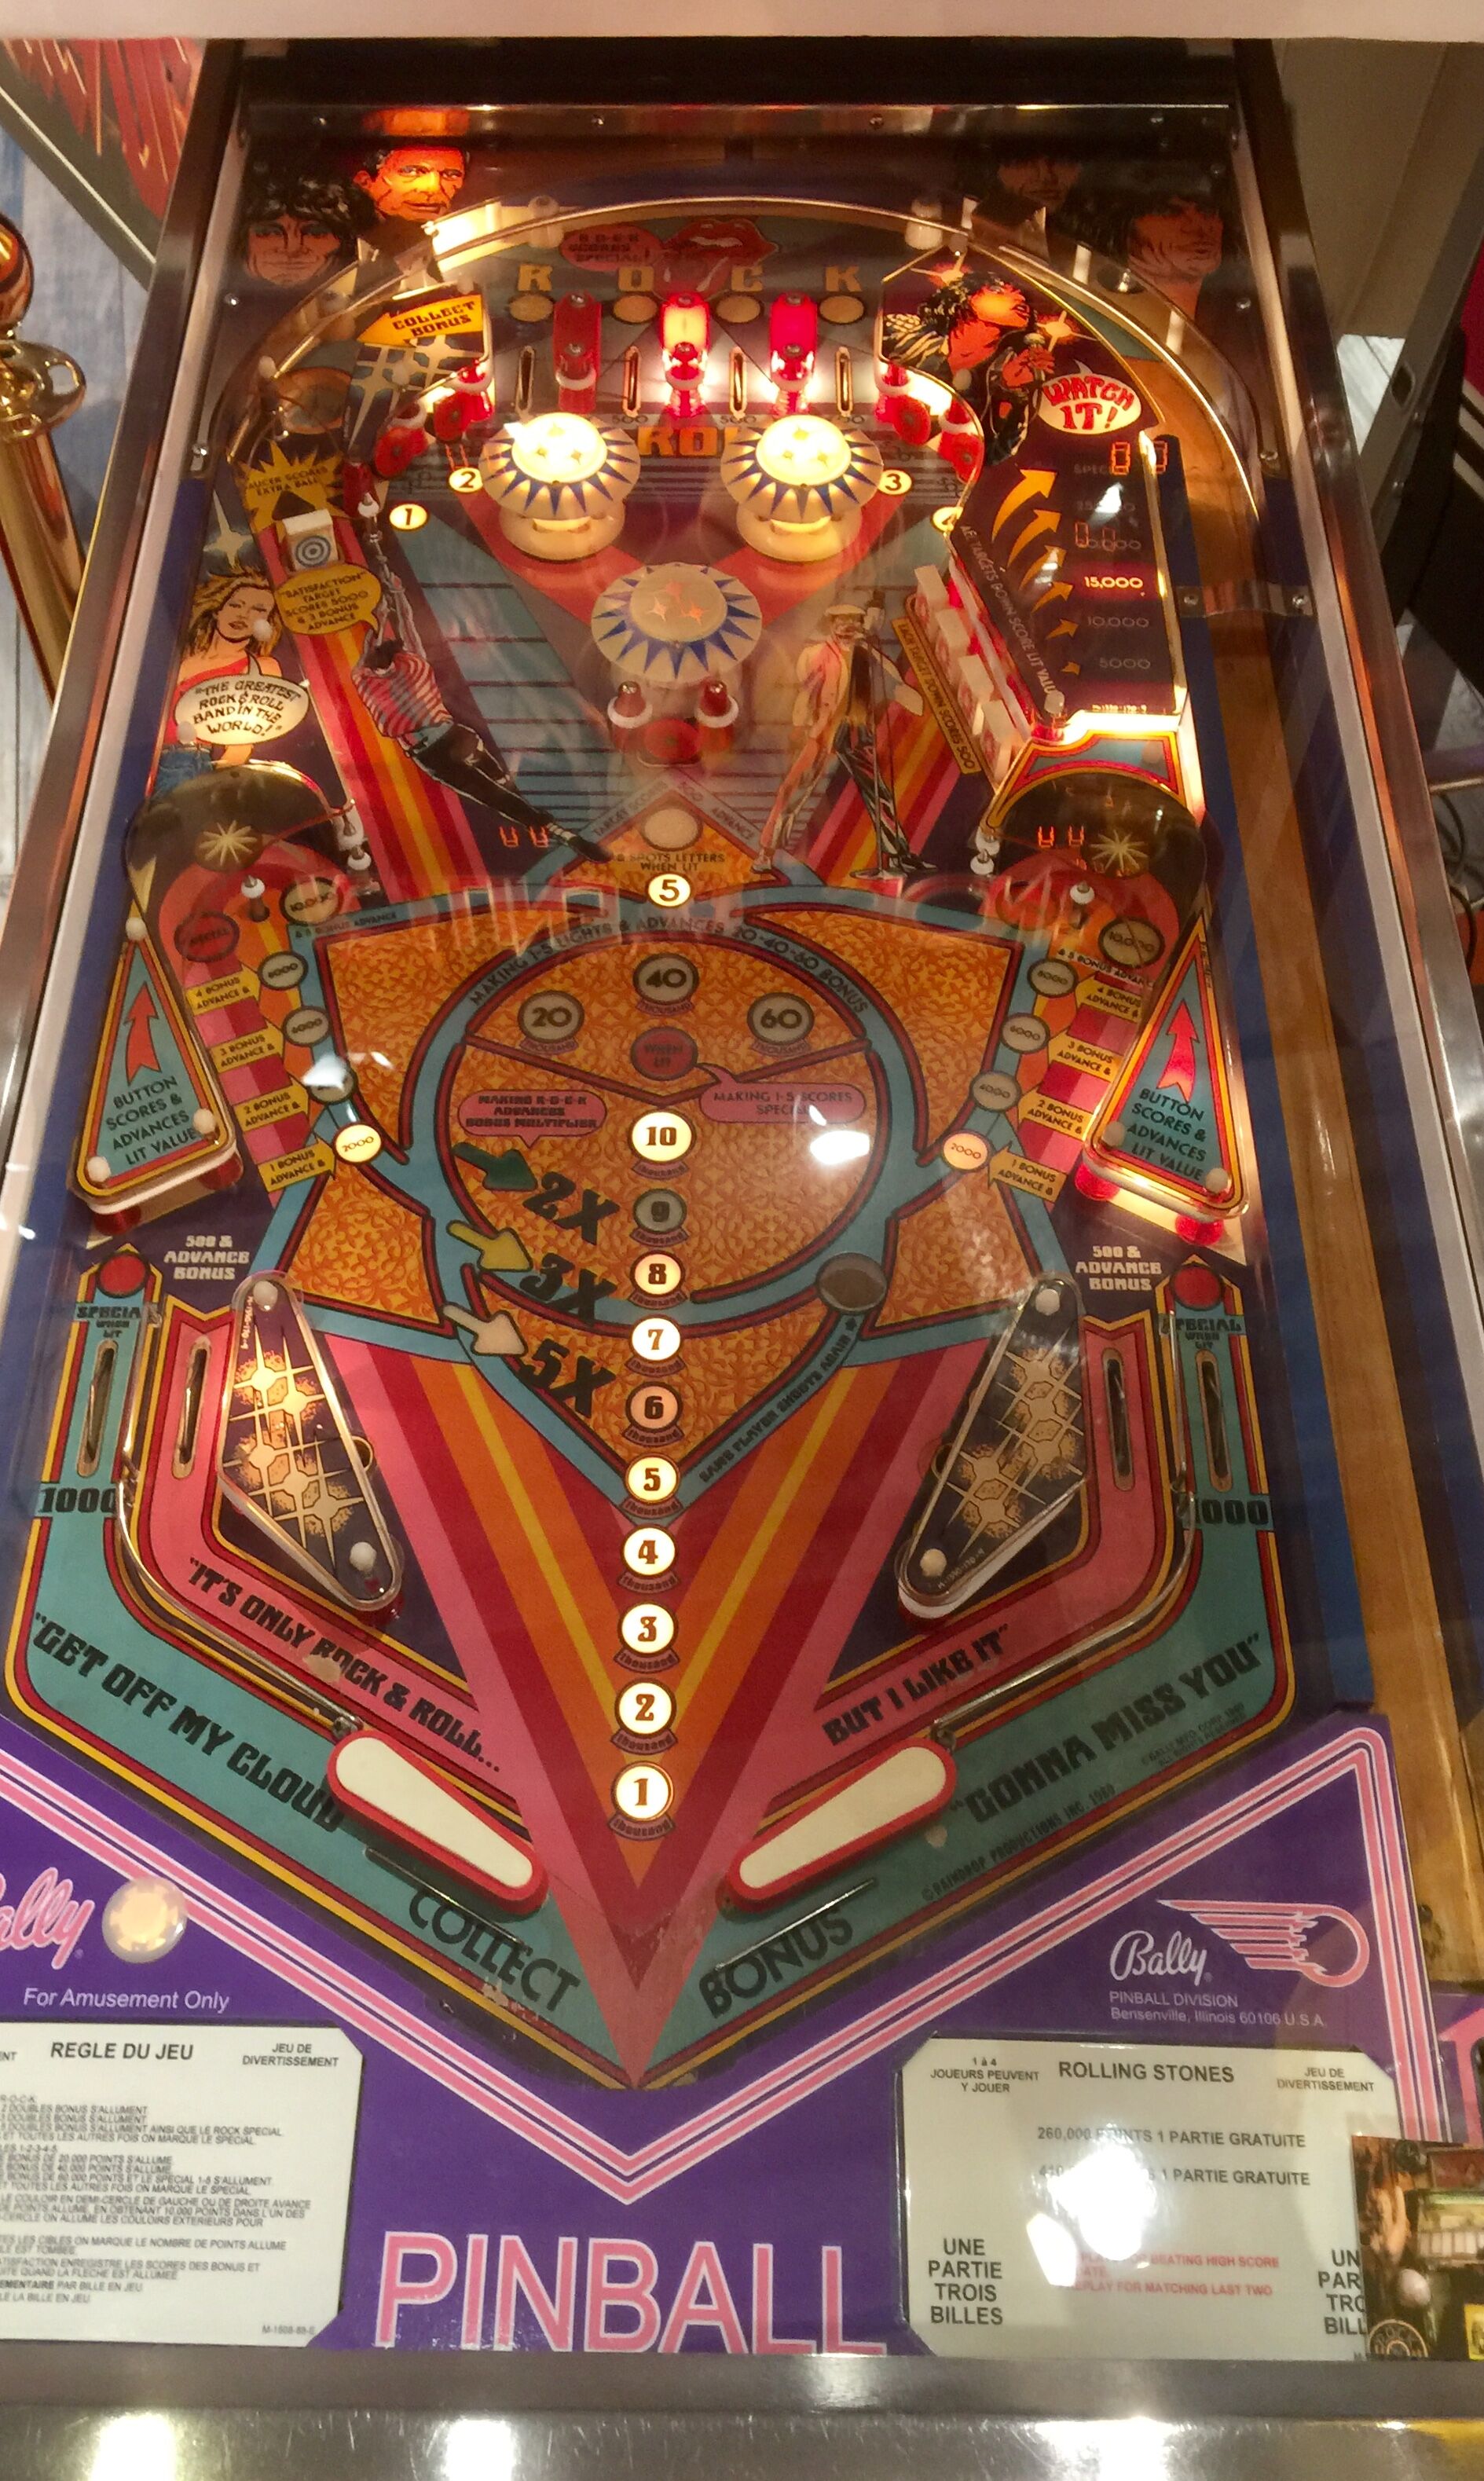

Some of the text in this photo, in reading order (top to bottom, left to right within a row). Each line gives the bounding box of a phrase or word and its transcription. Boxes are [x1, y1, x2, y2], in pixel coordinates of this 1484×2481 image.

[517, 264, 863, 292] R O C K
[392, 301, 476, 332] COLLECT
[411, 313, 471, 338] BONUS
[1041, 376, 1133, 411] WATCH
[1062, 401, 1117, 431] IT!
[459, 471, 476, 489] 2
[883, 474, 903, 492] 3
[404, 508, 413, 526] 1
[1083, 575, 1144, 589] 15,000
[285, 599, 328, 617] SCORES
[318, 603, 360, 618] BONUS
[307, 614, 357, 630] ADVANCE
[1008, 617, 1036, 651] SCORE
[199, 691, 284, 712] ROCK & ROLL
[235, 680, 302, 702] GREATEST
[193, 705, 282, 724] BAND IN THE
[640, 863, 698, 872] WHEN LIT
[676, 853, 726, 863] LETTERS
[658, 878, 680, 902] 5
[469, 957, 530, 1007] MAKING
[556, 921, 612, 951] LIGHTS
[634, 918, 725, 935] ADVANCES
[817, 964, 870, 1014] BONUS
[205, 977, 240, 994] BONUS
[645, 967, 688, 988] 40
[196, 991, 240, 1010] ADVANCE
[529, 1006, 572, 1028] 20
[759, 1008, 804, 1030] 60
[229, 1034, 266, 1053] BONUS
[1076, 1044, 1114, 1064] BONUS
[220, 1049, 264, 1068] ADVANCE
[1057, 1050, 1101, 1072] ADVANCE
[113, 1076, 178, 1109] BUTTON
[254, 1091, 291, 1110] BONUS
[715, 1090, 852, 1103] MAKING SCORES
[105, 1092, 183, 1132] SCORES &
[1047, 1102, 1084, 1123] BONUS
[1138, 1087, 1205, 1122] BUTTON
[245, 1107, 289, 1127] ADVANCE
[1028, 1108, 1072, 1131] ADVANCE
[1131, 1103, 1208, 1142] SCORES &
[112, 1109, 190, 1152] ADVANCES
[644, 1125, 678, 1147] 10
[126, 1127, 197, 1165] LIT VALUE
[342, 1136, 375, 1153] 2000
[951, 1142, 982, 1160] 2000
[1127, 1122, 1207, 1163] ADVANCES
[278, 1149, 315, 1167] BONUS
[1131, 1144, 1204, 1182] LIT VALUE
[270, 1164, 315, 1186] ADVANCE
[998, 1169, 1043, 1192] ADVANCE
[1018, 1159, 1056, 1183] BONUS
[523, 1171, 620, 1245] 2X
[650, 1200, 672, 1222] 9
[185, 1234, 233, 1248] 500 &
[163, 1250, 250, 1264] ADVANCE
[1092, 1245, 1142, 1259] 500 &
[174, 1266, 236, 1281] BONUS
[647, 1263, 668, 1286] 8
[1075, 1261, 1163, 1275] ADVANCE
[518, 1251, 617, 1325] 3X
[1089, 1277, 1152, 1291] BONUS
[647, 1328, 665, 1350] 7
[518, 1338, 617, 1417] 5X
[643, 1395, 665, 1419] 6
[643, 1467, 661, 1492] 5
[42, 1487, 116, 1513] 1000
[637, 1539, 659, 1565] 4
[637, 1616, 658, 1642] 3
[240, 1596, 317, 1656] ONLY
[308, 1636, 387, 1702] ROCK
[383, 1680, 411, 1711] &
[821, 1705, 885, 1746] BUT
[890, 1689, 903, 1711] I
[904, 1649, 975, 1705] LIKE
[1097, 1687, 1187, 1752] MISS
[1178, 1633, 1263, 1703] YOU"
[635, 1693, 655, 1721] 2
[31, 1611, 346, 1832] "GET OFF MY CLOUD
[633, 1777, 649, 1806] 1
[0, 1867, 96, 1970] ally
[408, 1889, 581, 2012] COLLECT
[1109, 1930, 1207, 1986] Bally
[698, 1907, 854, 2019] BONUS
[24, 1988, 230, 2014] For Amusement Only
[1109, 1991, 1239, 2008] PINBALL DIVISION
[1111, 2007, 1191, 2024] Bensenville,
[1194, 2010, 1237, 2024] Illinois
[1239, 2012, 1281, 2025] 60106
[50, 2042, 194, 2061] REGLE DU JEU
[271, 2043, 313, 2054] JEU DE
[242, 2054, 339, 2068] DIVERTISSEMENT
[930, 2069, 1039, 2081] JOUEURS PEUVENT
[1059, 2061, 1235, 2083] ROLLING STONES
[1303, 2067, 1345, 2078] JEU DE
[961, 2083, 1010, 2093] Y JOUER
[1277, 2078, 1375, 2093] DIVERTISSEMENT
[157, 2135, 197, 2144] MARQUE
[213, 2126, 240, 2135] ROCK
[1037, 2127, 1306, 2148] 260,000 PARTIE GRATUITE
[156, 2175, 194, 2184] SPECIAL
[1174, 2169, 1310, 2186] PARTIE GRATUITE
[234, 2198, 312, 2209] DROITE AVANCE
[172, 2216, 264, 2227] EXTERIEURS POUR
[149, 2238, 288, 2250] NOMBRE DE POINTS ALLUME
[944, 2237, 986, 2256] UNE
[145, 2260, 261, 2272] SCORES DES BONUS ET
[928, 2259, 1002, 2280] PARTIE
[1151, 2254, 1203, 2266] BEATING
[1206, 2256, 1237, 2267] HIGH
[1239, 2257, 1280, 2268] SCORE
[373, 2230, 888, 2356] PINBALL
[935, 2281, 998, 2303] TROIS
[1145, 2282, 1273, 2296] MATCHING LAST TWO
[930, 2305, 1003, 2325] BILLES
